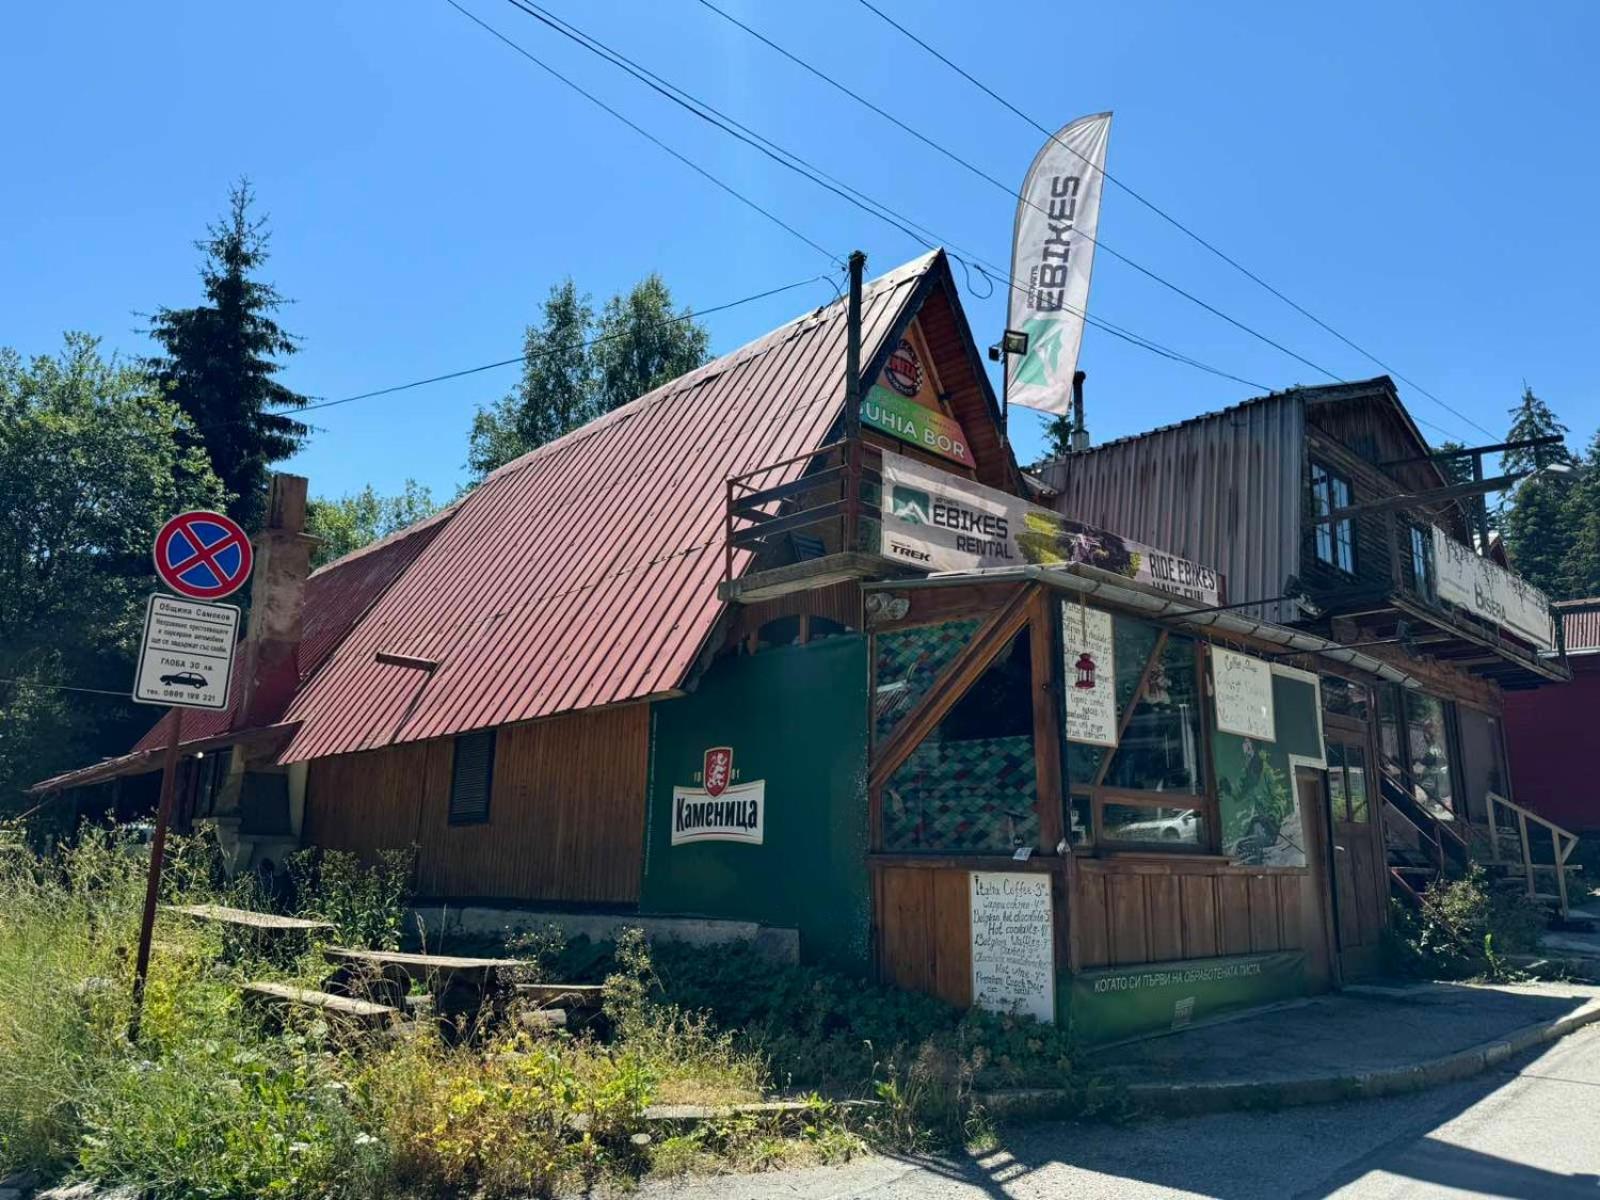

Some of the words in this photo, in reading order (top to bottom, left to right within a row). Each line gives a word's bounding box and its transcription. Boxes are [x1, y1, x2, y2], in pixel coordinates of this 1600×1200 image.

[1036, 176, 1080, 311] EBIKES
[924, 428, 965, 458] BOR
[933, 504, 1008, 539] EBIKES
[890, 544, 931, 561] TREK
[956, 535, 1013, 559] RENTAL
[1149, 553, 1176, 582] RIDE
[1177, 560, 1215, 590] EBIKES
[159, 603, 192, 614] Община
[196, 608, 230, 620] Самоков
[160, 657, 186, 667] ГЛОБА
[189, 661, 200, 670] 30
[676, 798, 758, 832] Каменица
[1094, 977, 1127, 992] КОГАТО
[1129, 975, 1141, 989] СИ
[1143, 972, 1171, 987] ПЪРВИ
